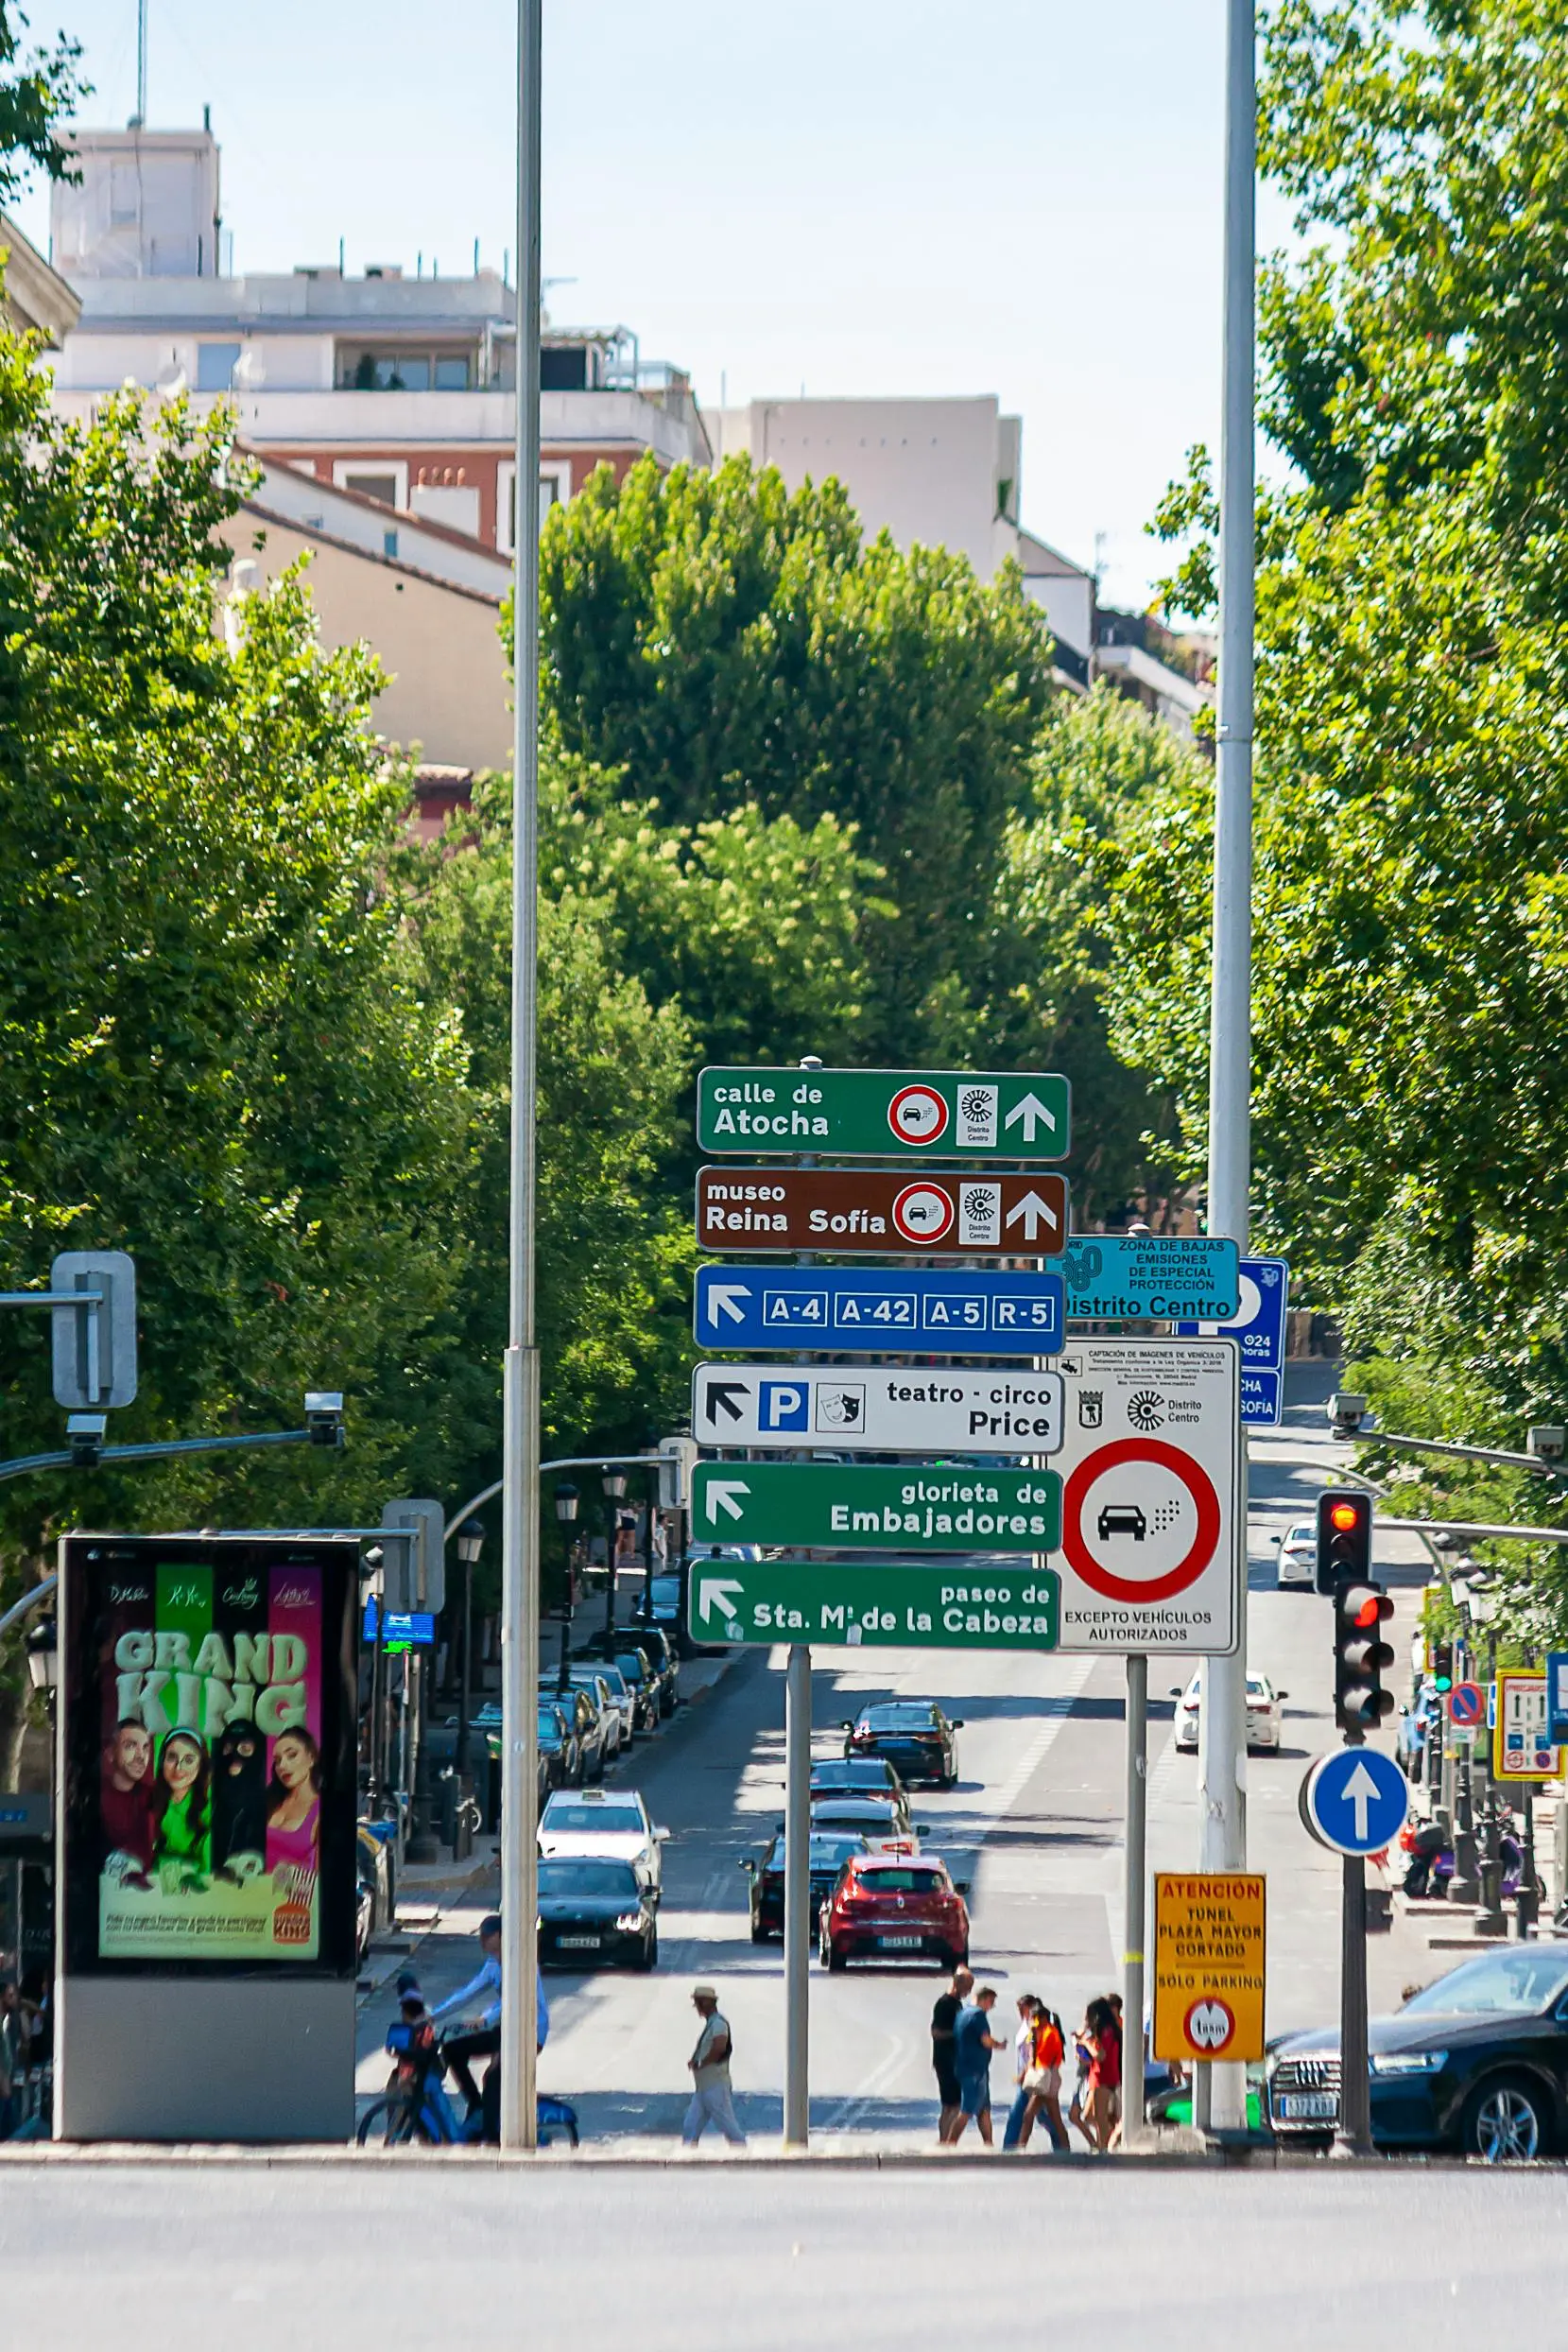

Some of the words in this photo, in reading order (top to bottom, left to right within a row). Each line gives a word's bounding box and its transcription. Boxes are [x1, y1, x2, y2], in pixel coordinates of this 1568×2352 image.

[714, 1083, 775, 1105] calle
[792, 1084, 822, 1104] de
[713, 1108, 829, 1135] Atocha
[707, 1185, 785, 1202] museo
[706, 1206, 788, 1232] Reina
[808, 1209, 887, 1234] Sofía
[1119, 1240, 1155, 1252] ZONA
[1160, 1241, 1177, 1252] DE
[1181, 1241, 1225, 1252] BAJAS
[1136, 1254, 1207, 1265] EMISIONES
[1129, 1267, 1146, 1277] DE
[1150, 1267, 1215, 1277] ESPECIAL
[1129, 1279, 1215, 1290] PROTECCIÓN
[770, 1298, 820, 1321] A-4
[841, 1299, 910, 1323] A-42
[931, 1302, 980, 1324] A-5
[999, 1303, 1047, 1325] R-5
[1067, 1295, 1141, 1315] istrito
[1149, 1296, 1230, 1316] Centro
[887, 1382, 964, 1403] teatro
[990, 1386, 1052, 1405] circo
[769, 1387, 801, 1427] P
[1168, 1400, 1201, 1410] Distrito
[969, 1411, 1050, 1437] Price
[1168, 1412, 1199, 1423] Centro
[901, 1482, 999, 1505] glorieta
[1017, 1484, 1046, 1504] de
[831, 1505, 1045, 1538] Embajadores
[940, 1585, 1011, 1605] paseo
[1022, 1585, 1050, 1603] de
[753, 1604, 810, 1629] Sta.
[862, 1607, 896, 1630] de
[906, 1607, 932, 1632] la
[943, 1609, 1048, 1634] Cabeza
[1065, 1612, 1129, 1624] EXCEPTO
[1132, 1609, 1212, 1624] VEHÍCULOS
[1089, 1629, 1187, 1641] AUTORIZADOS
[114, 1632, 308, 1684] GRAND
[115, 1670, 308, 1737] KING
[1163, 1880, 1260, 1899] ATENCIÓN
[1212, 1924, 1262, 1940] MAYOR
[1176, 1942, 1246, 1957] CORTADO
[1202, 1974, 1263, 1990] PARKING
